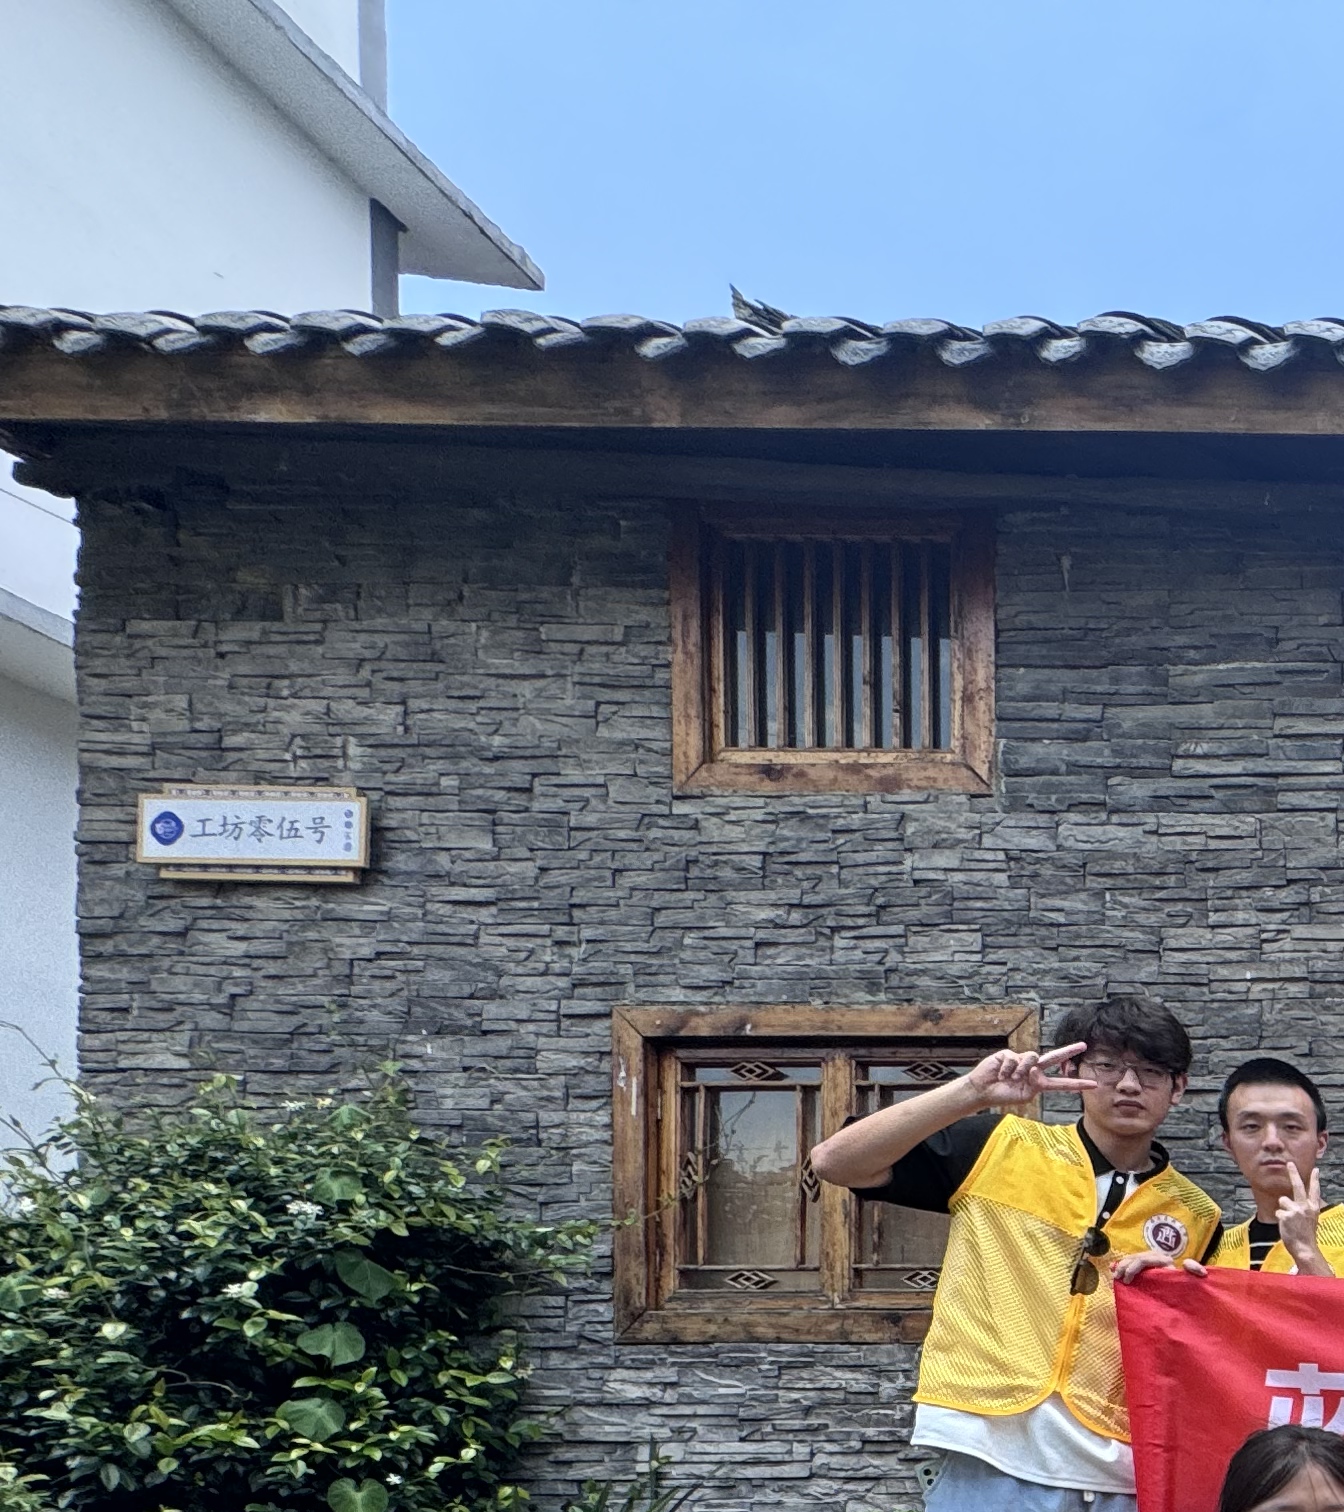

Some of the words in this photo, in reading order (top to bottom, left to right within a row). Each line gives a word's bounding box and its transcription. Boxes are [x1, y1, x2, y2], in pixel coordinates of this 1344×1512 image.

[189, 814, 332, 844] 工坊零伍号
